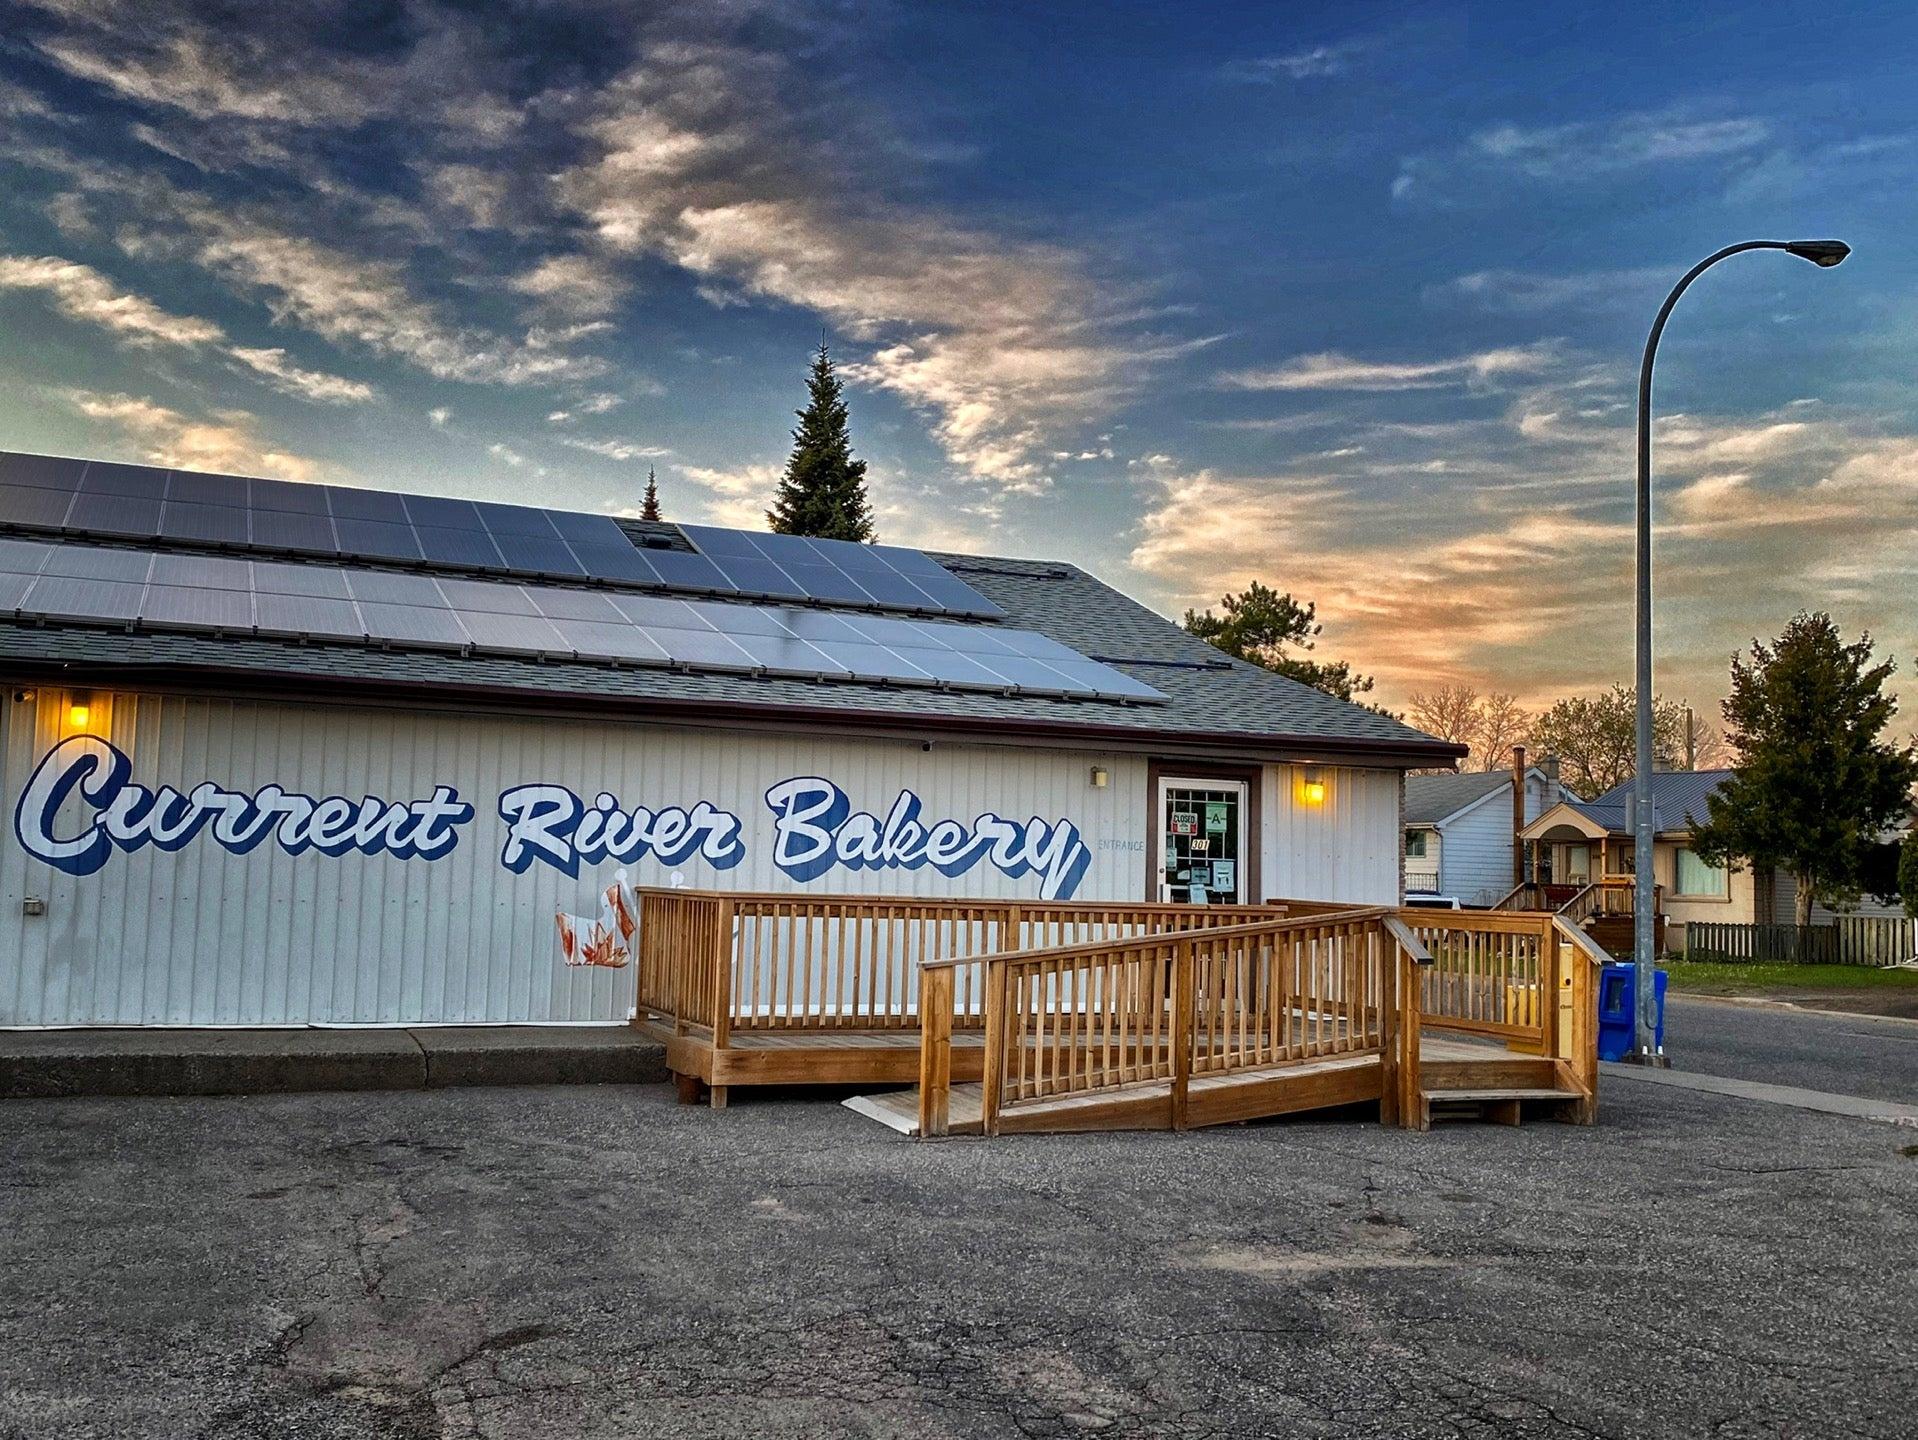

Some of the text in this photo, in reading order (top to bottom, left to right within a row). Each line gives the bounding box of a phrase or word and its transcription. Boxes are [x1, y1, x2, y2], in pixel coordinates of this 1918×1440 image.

[14, 734, 1092, 900] Current River Bakery
[1173, 814, 1195, 823] CLOSED
[1098, 839, 1144, 851] ENTRANCE
[1192, 840, 1208, 850] 301
